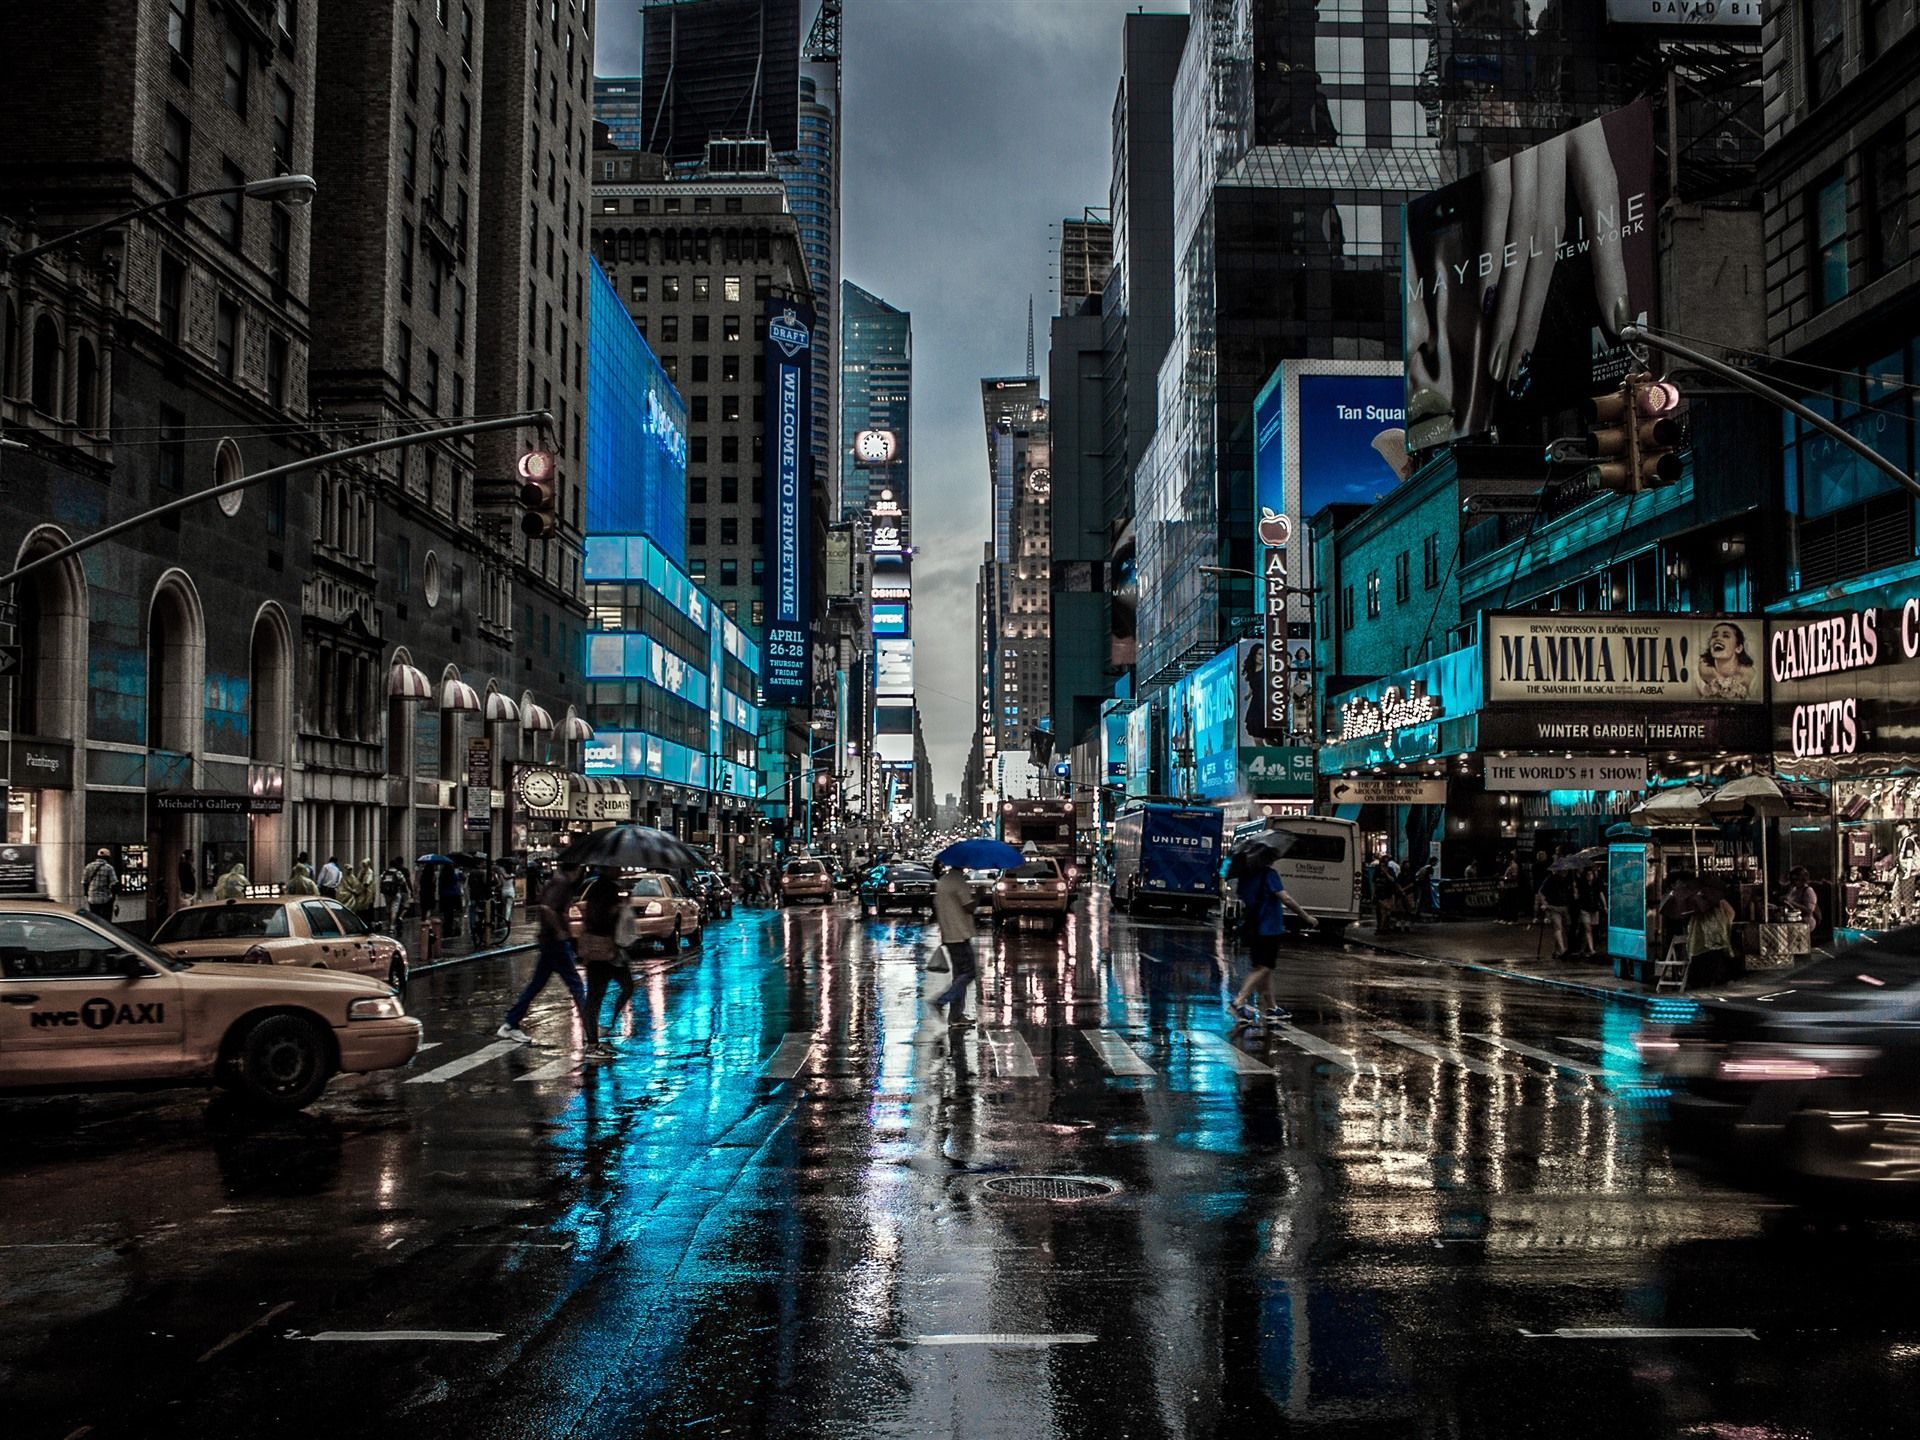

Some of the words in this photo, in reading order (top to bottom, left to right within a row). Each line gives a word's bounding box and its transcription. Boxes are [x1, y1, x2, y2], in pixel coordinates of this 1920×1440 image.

[1652, 2, 1704, 13] DAVID
[1406, 193, 1645, 303] MAYBELLINE
[1555, 239, 1590, 262] NEW
[1596, 220, 1644, 246] YORK
[773, 326, 805, 342] DRAFT
[780, 372, 797, 466] WELCOME
[1336, 405, 1362, 420] Tan
[781, 471, 794, 496] TO
[781, 501, 795, 615] PRIMETIME
[769, 629, 804, 643] APRIL
[1530, 625, 1553, 635] BENNY
[1554, 625, 1597, 635] ANDERSSON
[1598, 626, 1604, 635] &
[769, 643, 804, 656] 26-28
[1771, 607, 1879, 683] CAMERAS
[769, 659, 805, 669] THURSDAY
[1499, 635, 1615, 683] MAMMA
[1622, 636, 1689, 683] MIA!
[774, 669, 799, 677] FRIDAY
[769, 677, 804, 686] SATURDAY
[1527, 685, 1541, 695] THE
[1541, 685, 1567, 695] SMASH
[1569, 685, 1582, 695] HIT
[1583, 685, 1615, 695] MUSICAL
[1639, 686, 1665, 695] ABBA
[1538, 723, 1589, 738] WINTER
[1592, 724, 1644, 738] GARDEN
[1647, 724, 1706, 739] THEATRE
[1792, 697, 1858, 758] GIFTS
[26, 752, 60, 772] Paintings
[1248, 755, 1267, 776] 4
[1491, 766, 1516, 779] THE
[1519, 767, 1577, 780] WORLD'S
[1580, 768, 1595, 780] #1
[1599, 768, 1642, 780] SHOW!
[157, 798, 204, 809] Michael's
[205, 799, 243, 813] Gallery
[1151, 835, 1199, 846] UNITED
[30, 1011, 81, 1027] NYC
[81, 997, 164, 1030] TAXI
